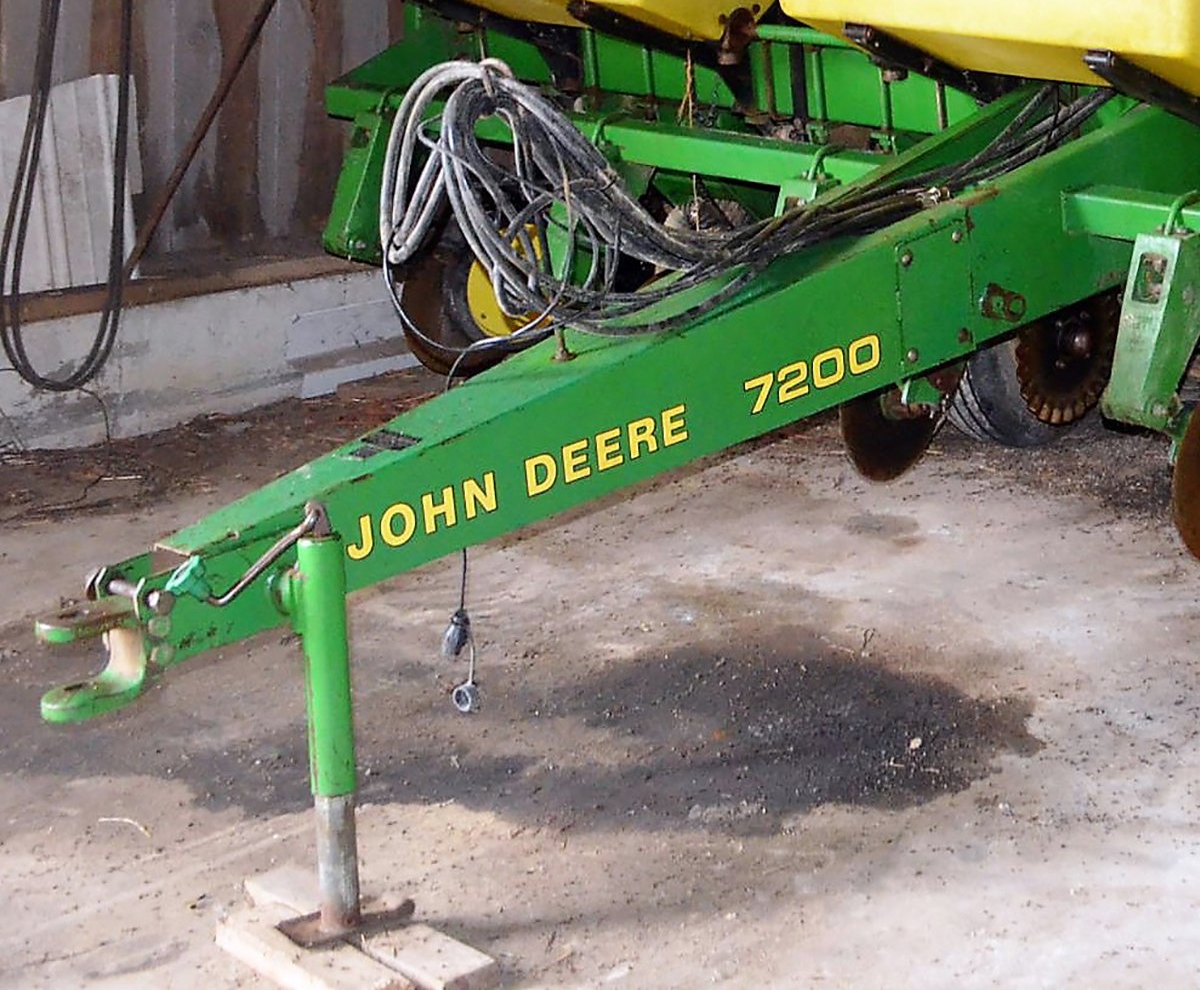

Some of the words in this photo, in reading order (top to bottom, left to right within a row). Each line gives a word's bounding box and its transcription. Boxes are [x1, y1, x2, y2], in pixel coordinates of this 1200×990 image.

[346, 471, 498, 560] JOHN
[523, 403, 689, 498] DEERE
[743, 334, 882, 416] 7200
